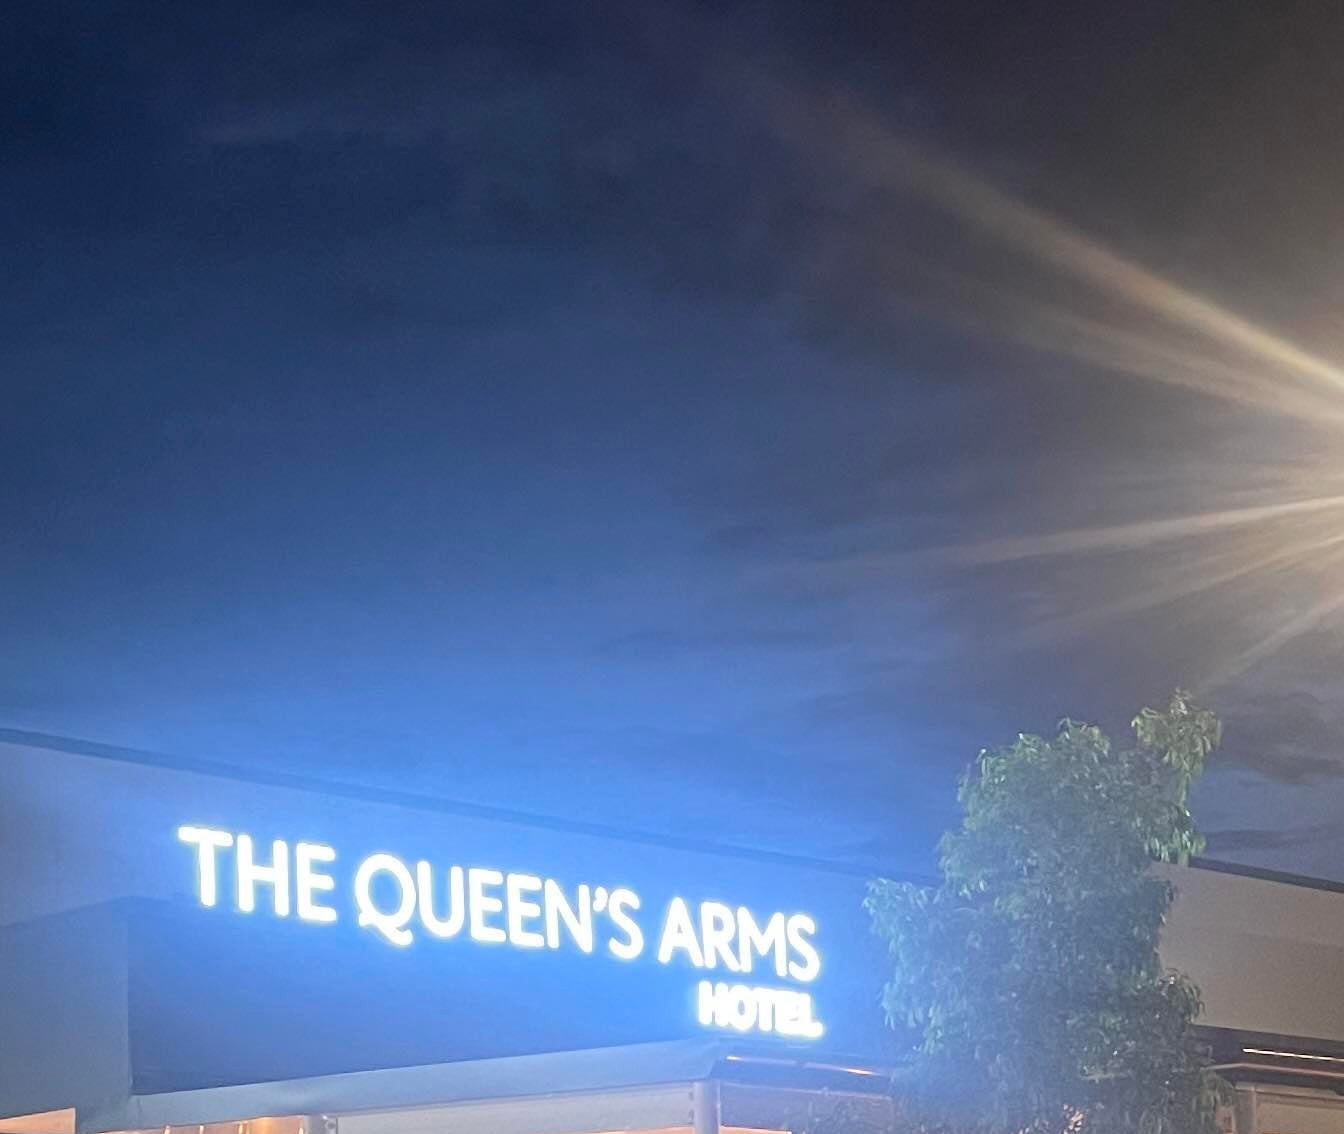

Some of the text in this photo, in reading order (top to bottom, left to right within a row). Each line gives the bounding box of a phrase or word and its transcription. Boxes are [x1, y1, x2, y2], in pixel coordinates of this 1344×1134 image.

[178, 826, 821, 982] THE QUEEN'S ARMS
[697, 980, 824, 1038] HOTEL
